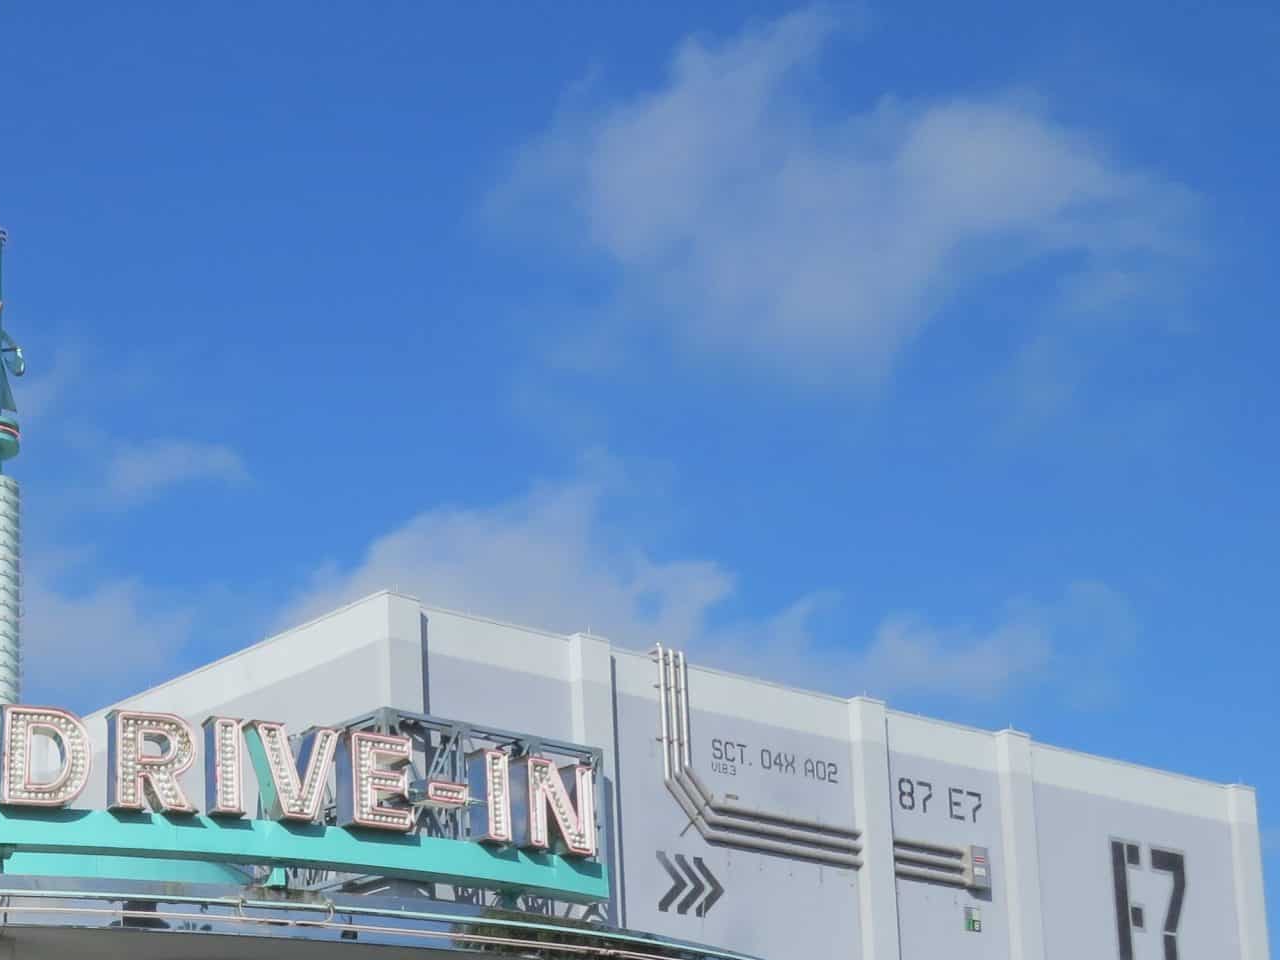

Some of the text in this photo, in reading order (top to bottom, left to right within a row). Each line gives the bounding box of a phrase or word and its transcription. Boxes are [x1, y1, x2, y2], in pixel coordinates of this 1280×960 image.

[0, 704, 597, 857] DRIVE-IN
[711, 738, 752, 766] SCT.
[804, 758, 839, 784] A02
[898, 777, 982, 823] 87 E7
